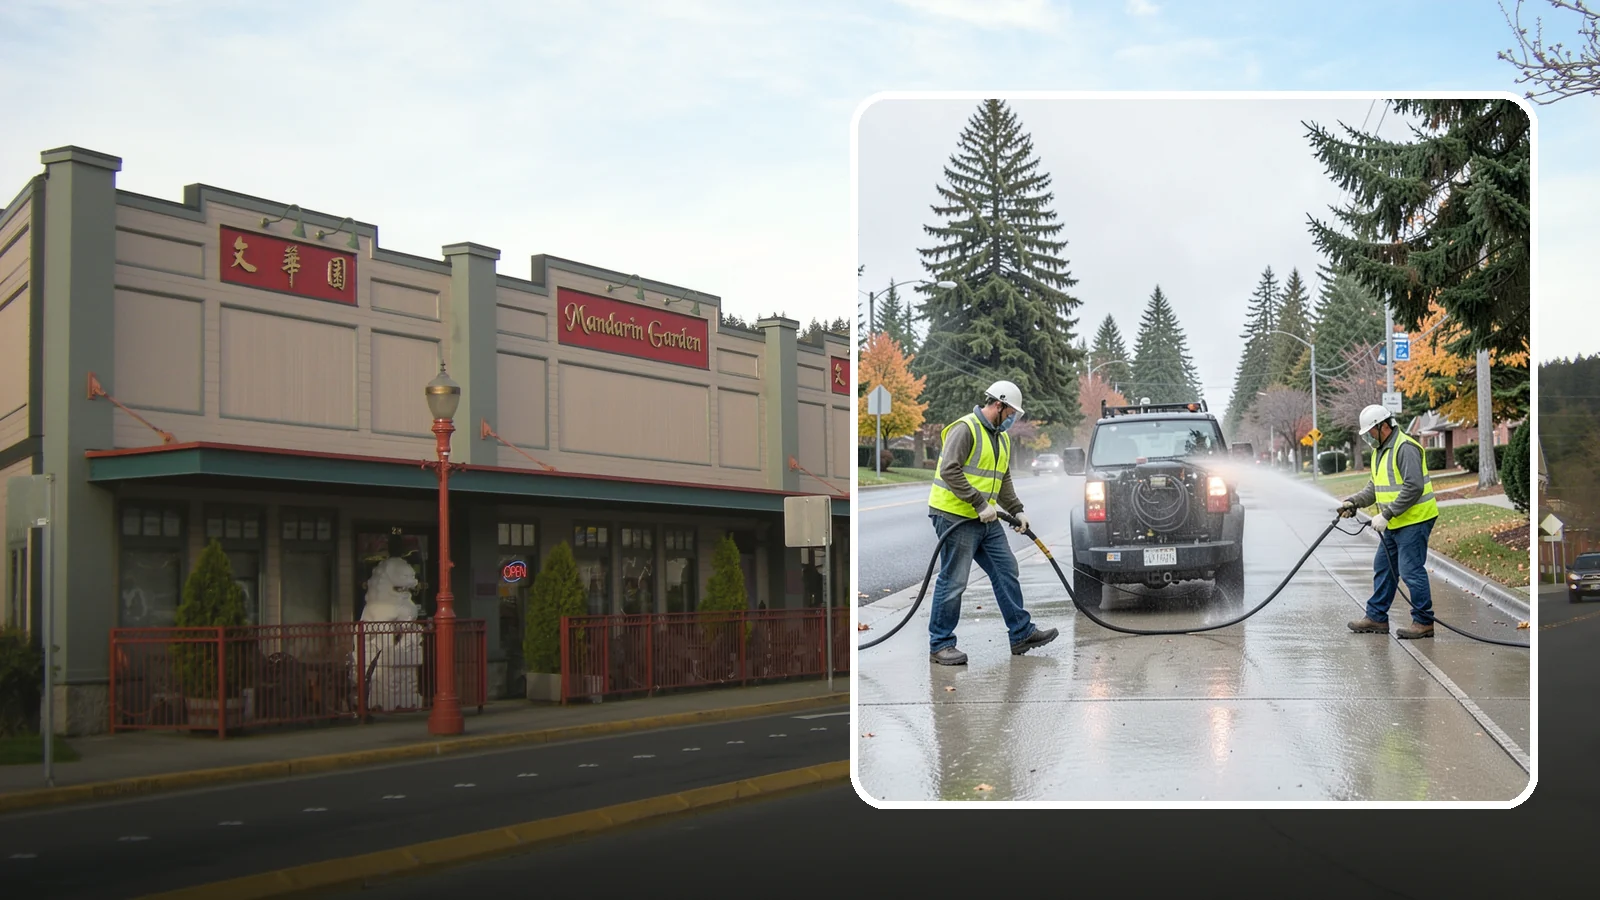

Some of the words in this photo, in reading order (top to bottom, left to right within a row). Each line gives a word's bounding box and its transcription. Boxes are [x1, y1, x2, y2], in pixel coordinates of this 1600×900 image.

[231, 236, 347, 291] 文華園
[564, 302, 644, 341] Mandarin
[648, 320, 701, 352] Garden
[503, 565, 527, 578] OPEN
